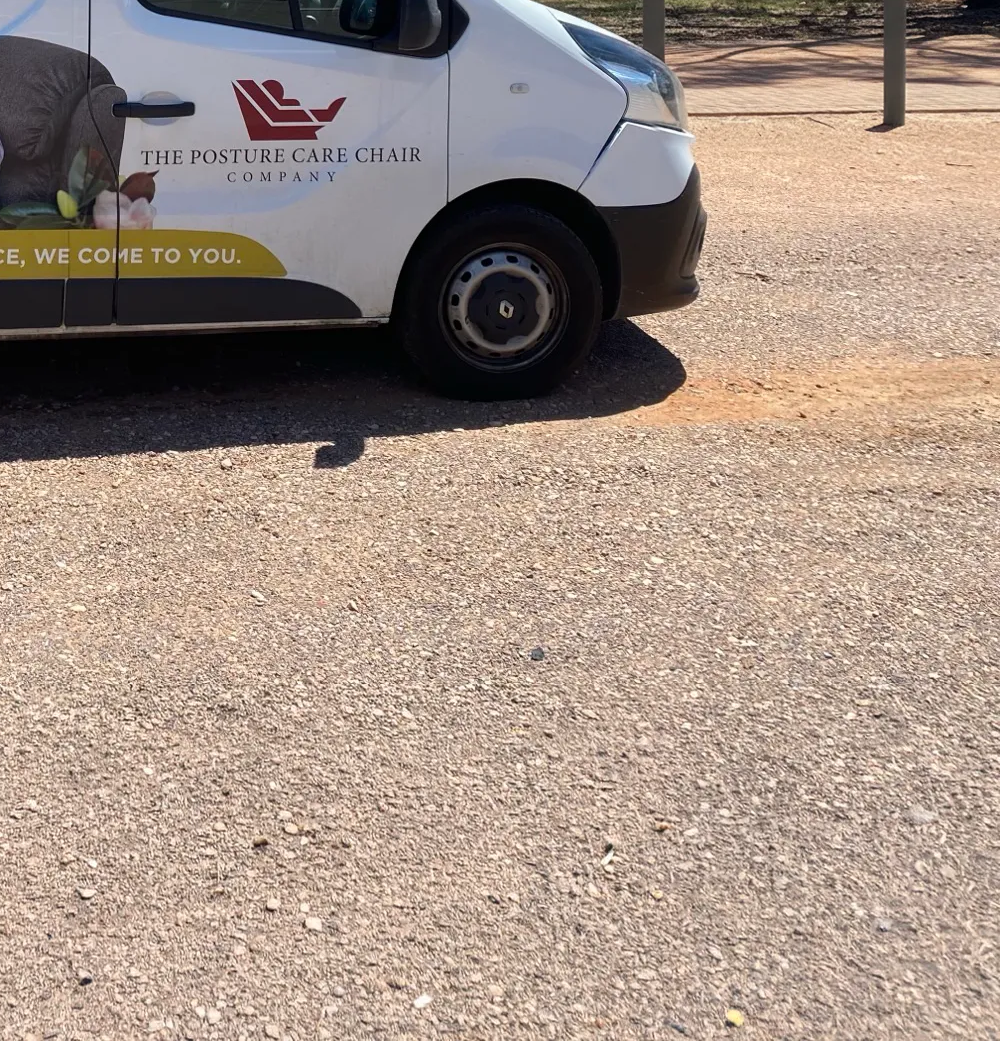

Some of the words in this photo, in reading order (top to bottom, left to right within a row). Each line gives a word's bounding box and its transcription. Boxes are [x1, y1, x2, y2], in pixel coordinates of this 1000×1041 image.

[140, 149, 184, 166] THE
[190, 148, 285, 165] POSTURE
[292, 147, 349, 164] CARE
[355, 146, 422, 163] CHAIR
[227, 170, 337, 183] COMPANY
[34, 248, 70, 265] WE
[78, 247, 143, 264] COME
[151, 247, 181, 265] TO
[188, 247, 242, 264] YOU.
